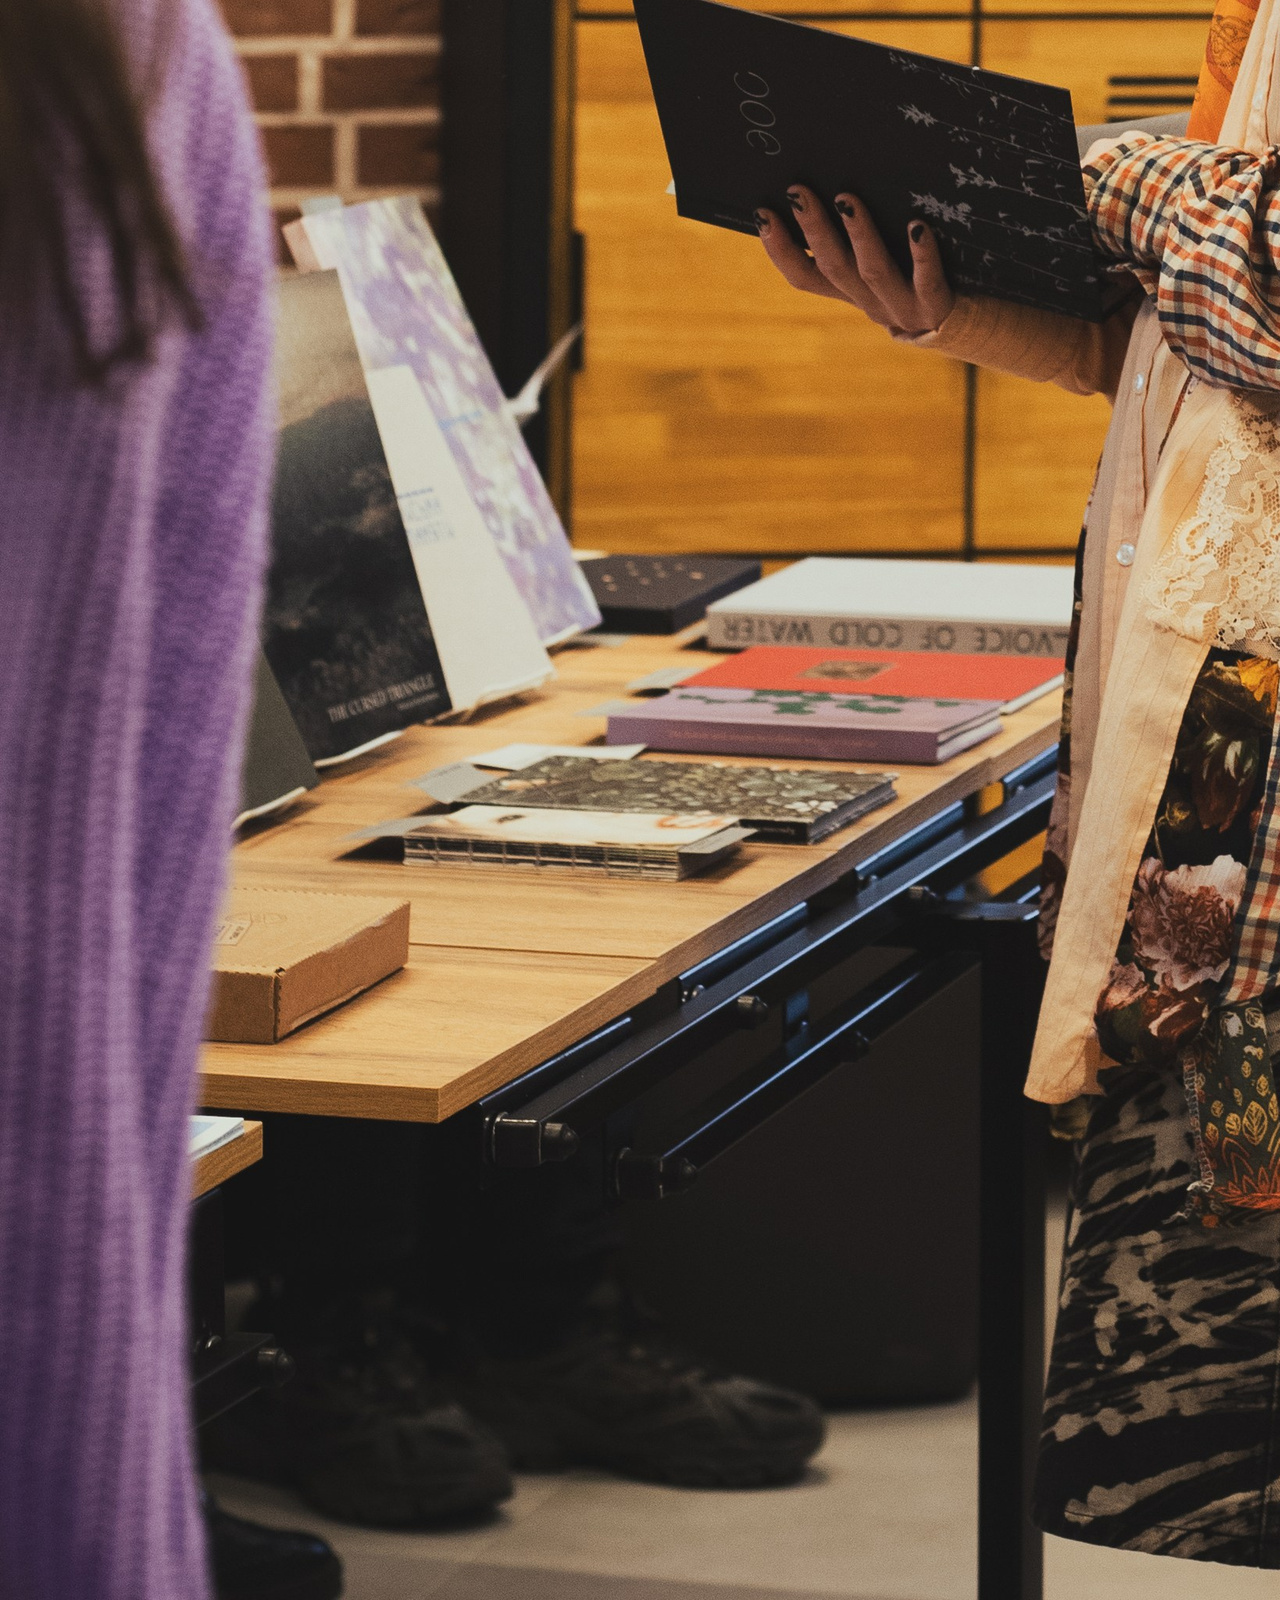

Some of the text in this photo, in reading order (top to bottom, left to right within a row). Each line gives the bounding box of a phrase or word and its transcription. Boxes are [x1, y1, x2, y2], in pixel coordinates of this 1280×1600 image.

[722, 617, 814, 645] WATER
[828, 621, 904, 649] COLD
[922, 626, 957, 651] OF
